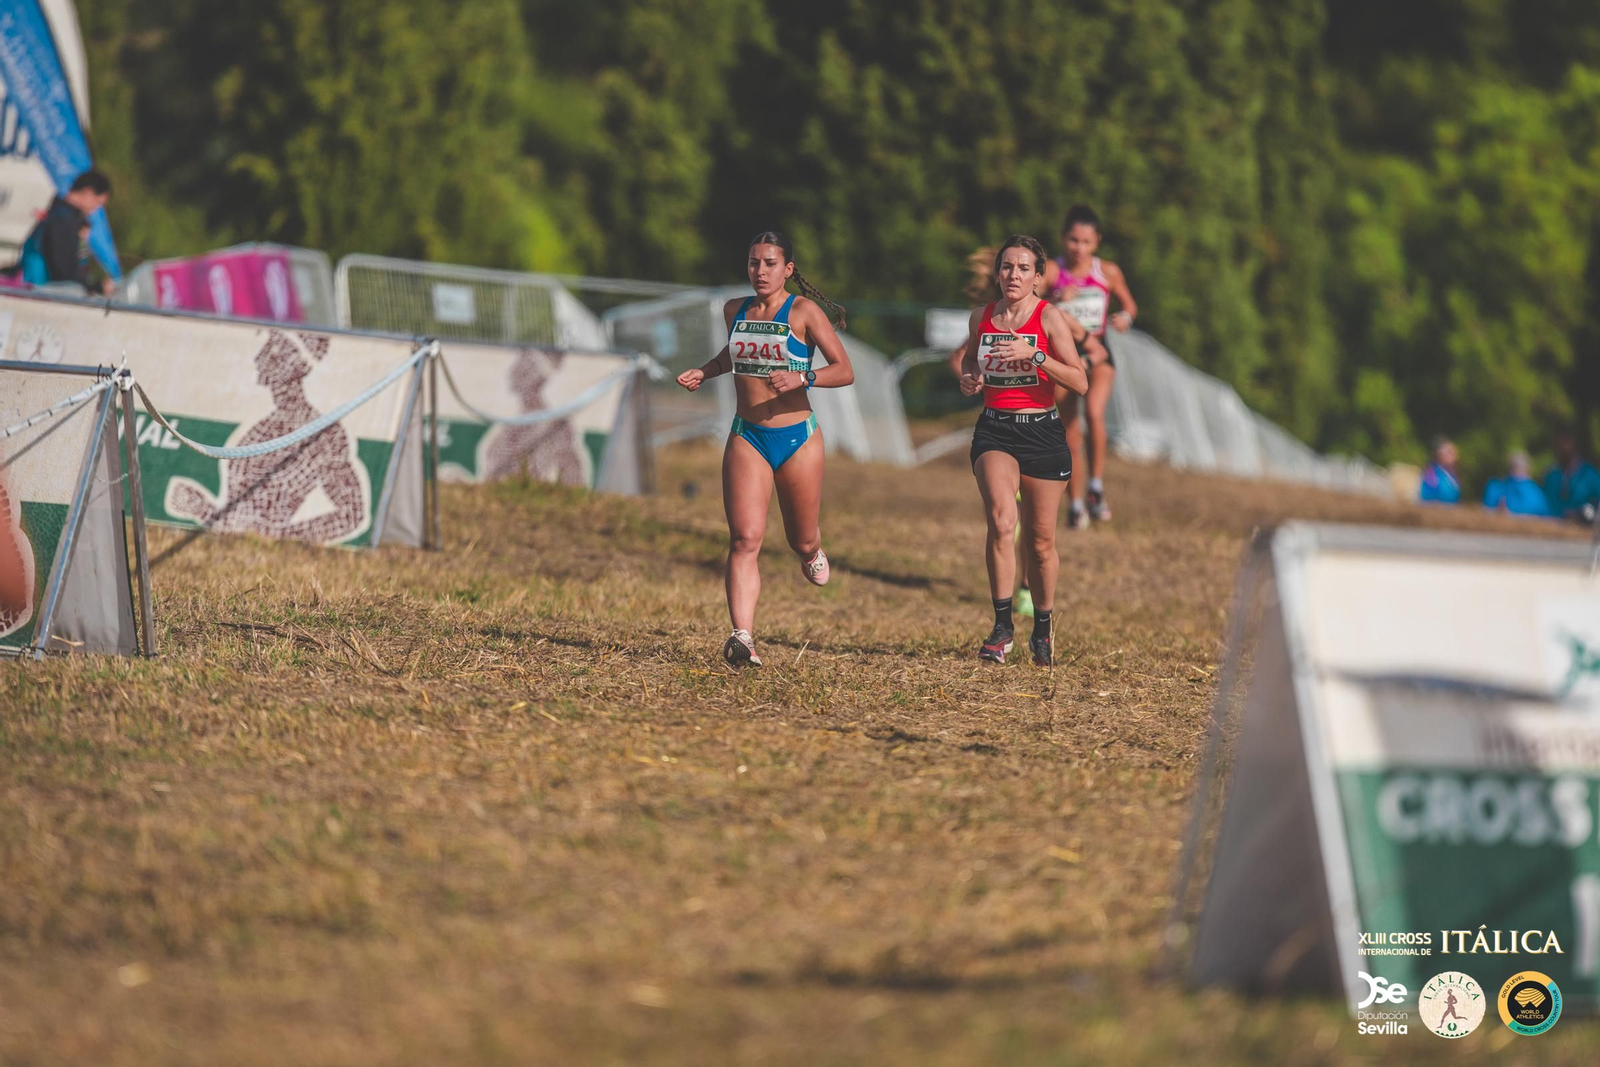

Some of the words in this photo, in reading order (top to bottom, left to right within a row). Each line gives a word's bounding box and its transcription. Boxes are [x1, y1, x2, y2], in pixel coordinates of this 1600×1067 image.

[735, 341, 785, 361] 2241
[983, 354, 1032, 372] 2246
[1015, 414, 1030, 424] NIKE
[1376, 773, 1592, 850] CROSS
